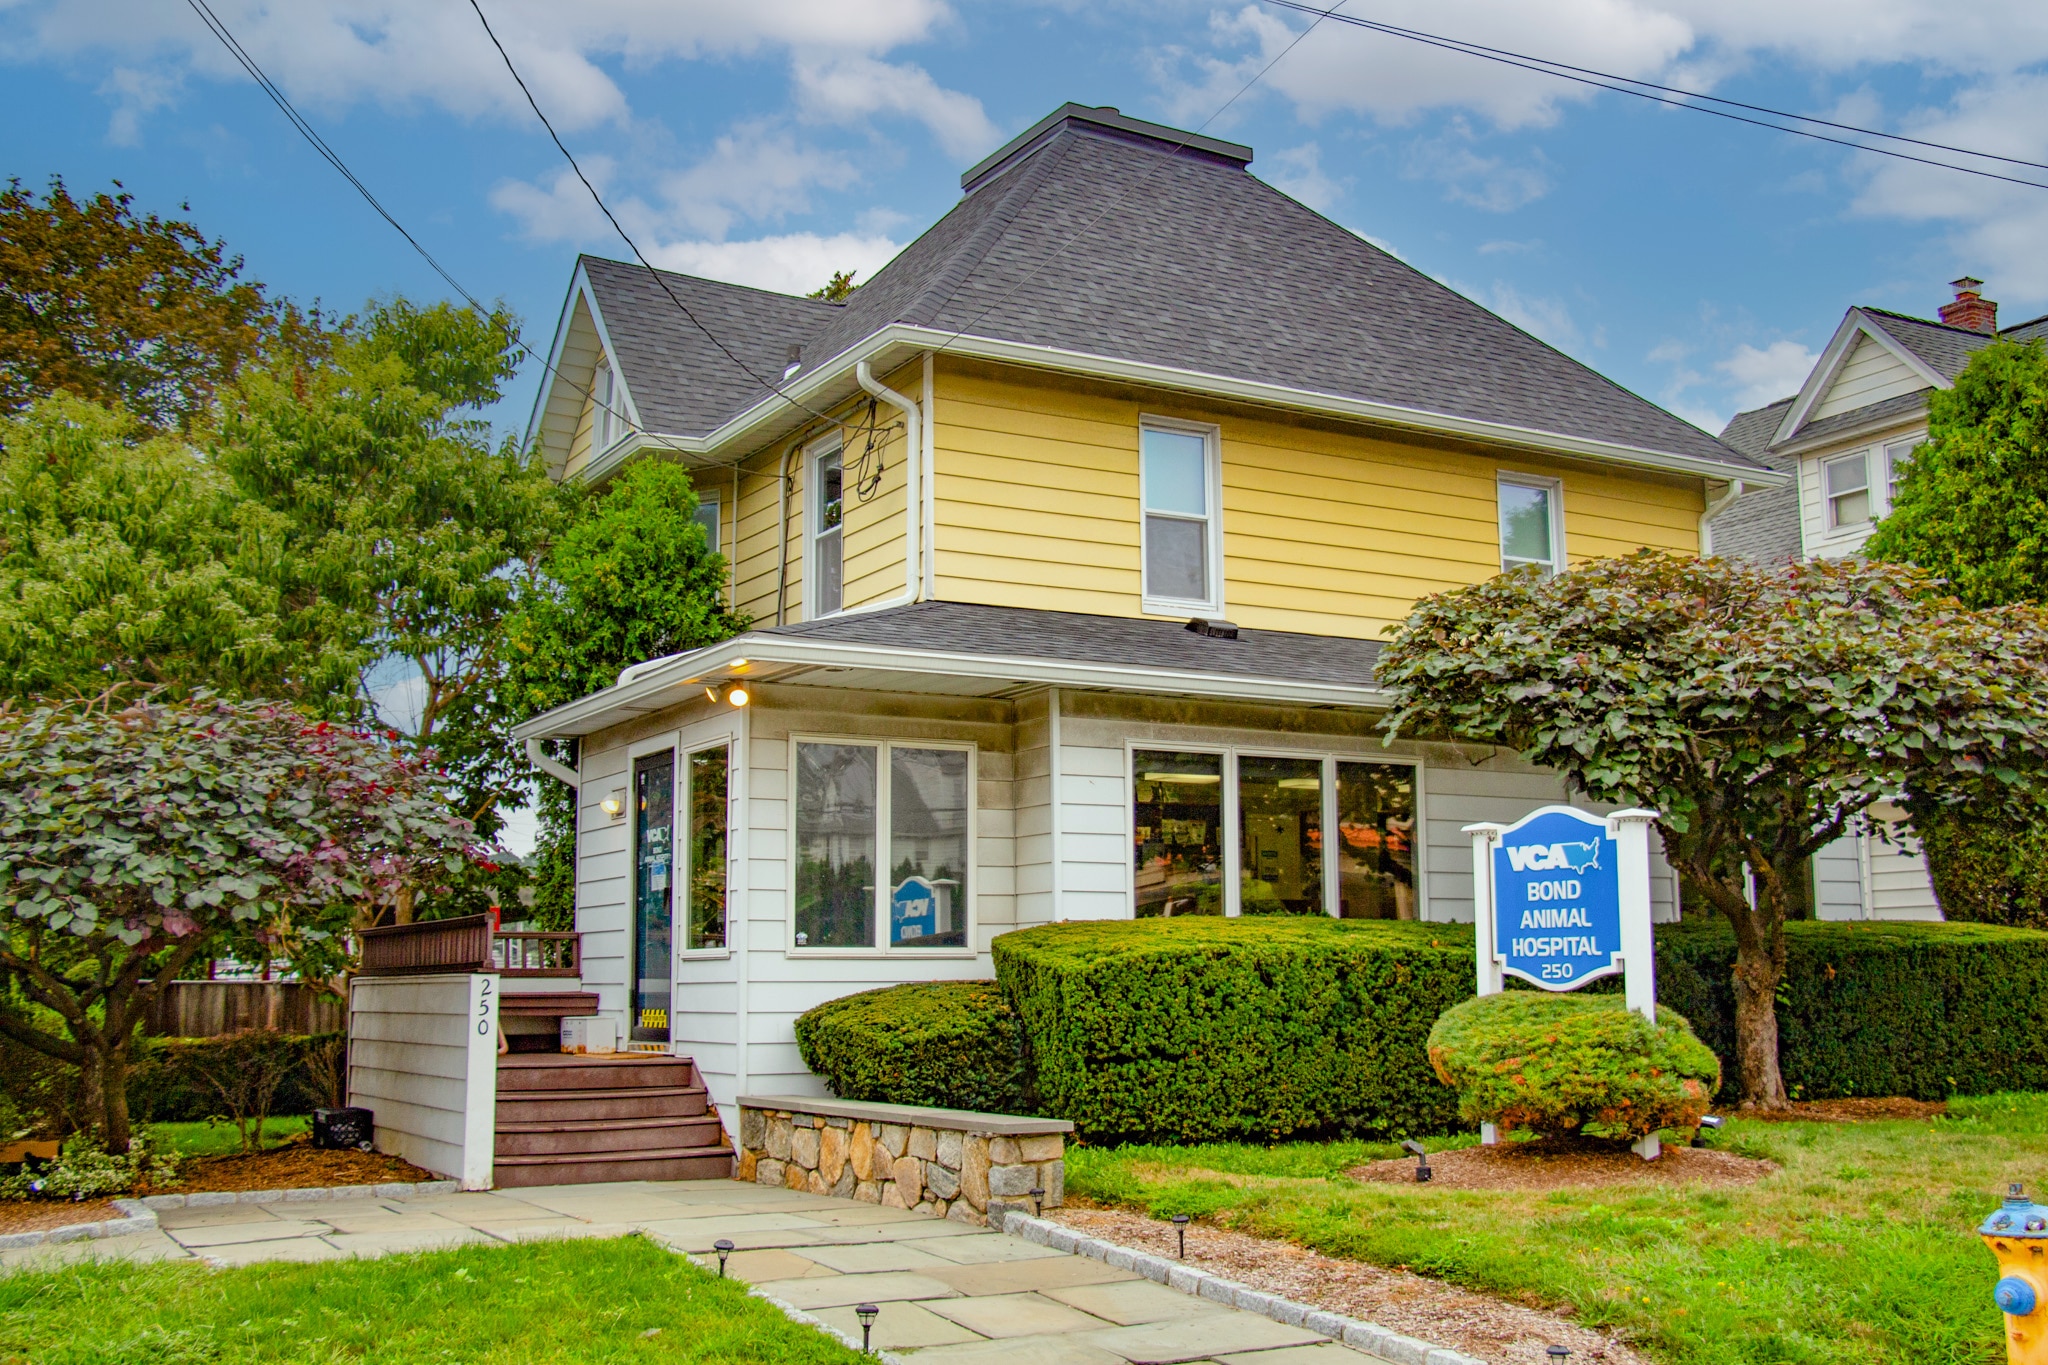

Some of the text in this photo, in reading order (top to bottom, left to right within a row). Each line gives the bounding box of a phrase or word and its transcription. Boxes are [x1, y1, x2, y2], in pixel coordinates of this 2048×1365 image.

[1506, 844, 1571, 871] VCA
[1527, 880, 1581, 901] BOND
[1520, 908, 1592, 929] ANIMAL
[1512, 936, 1602, 957] HOSPITAL
[1541, 963, 1573, 978] 250
[478, 978, 492, 1036] 250
